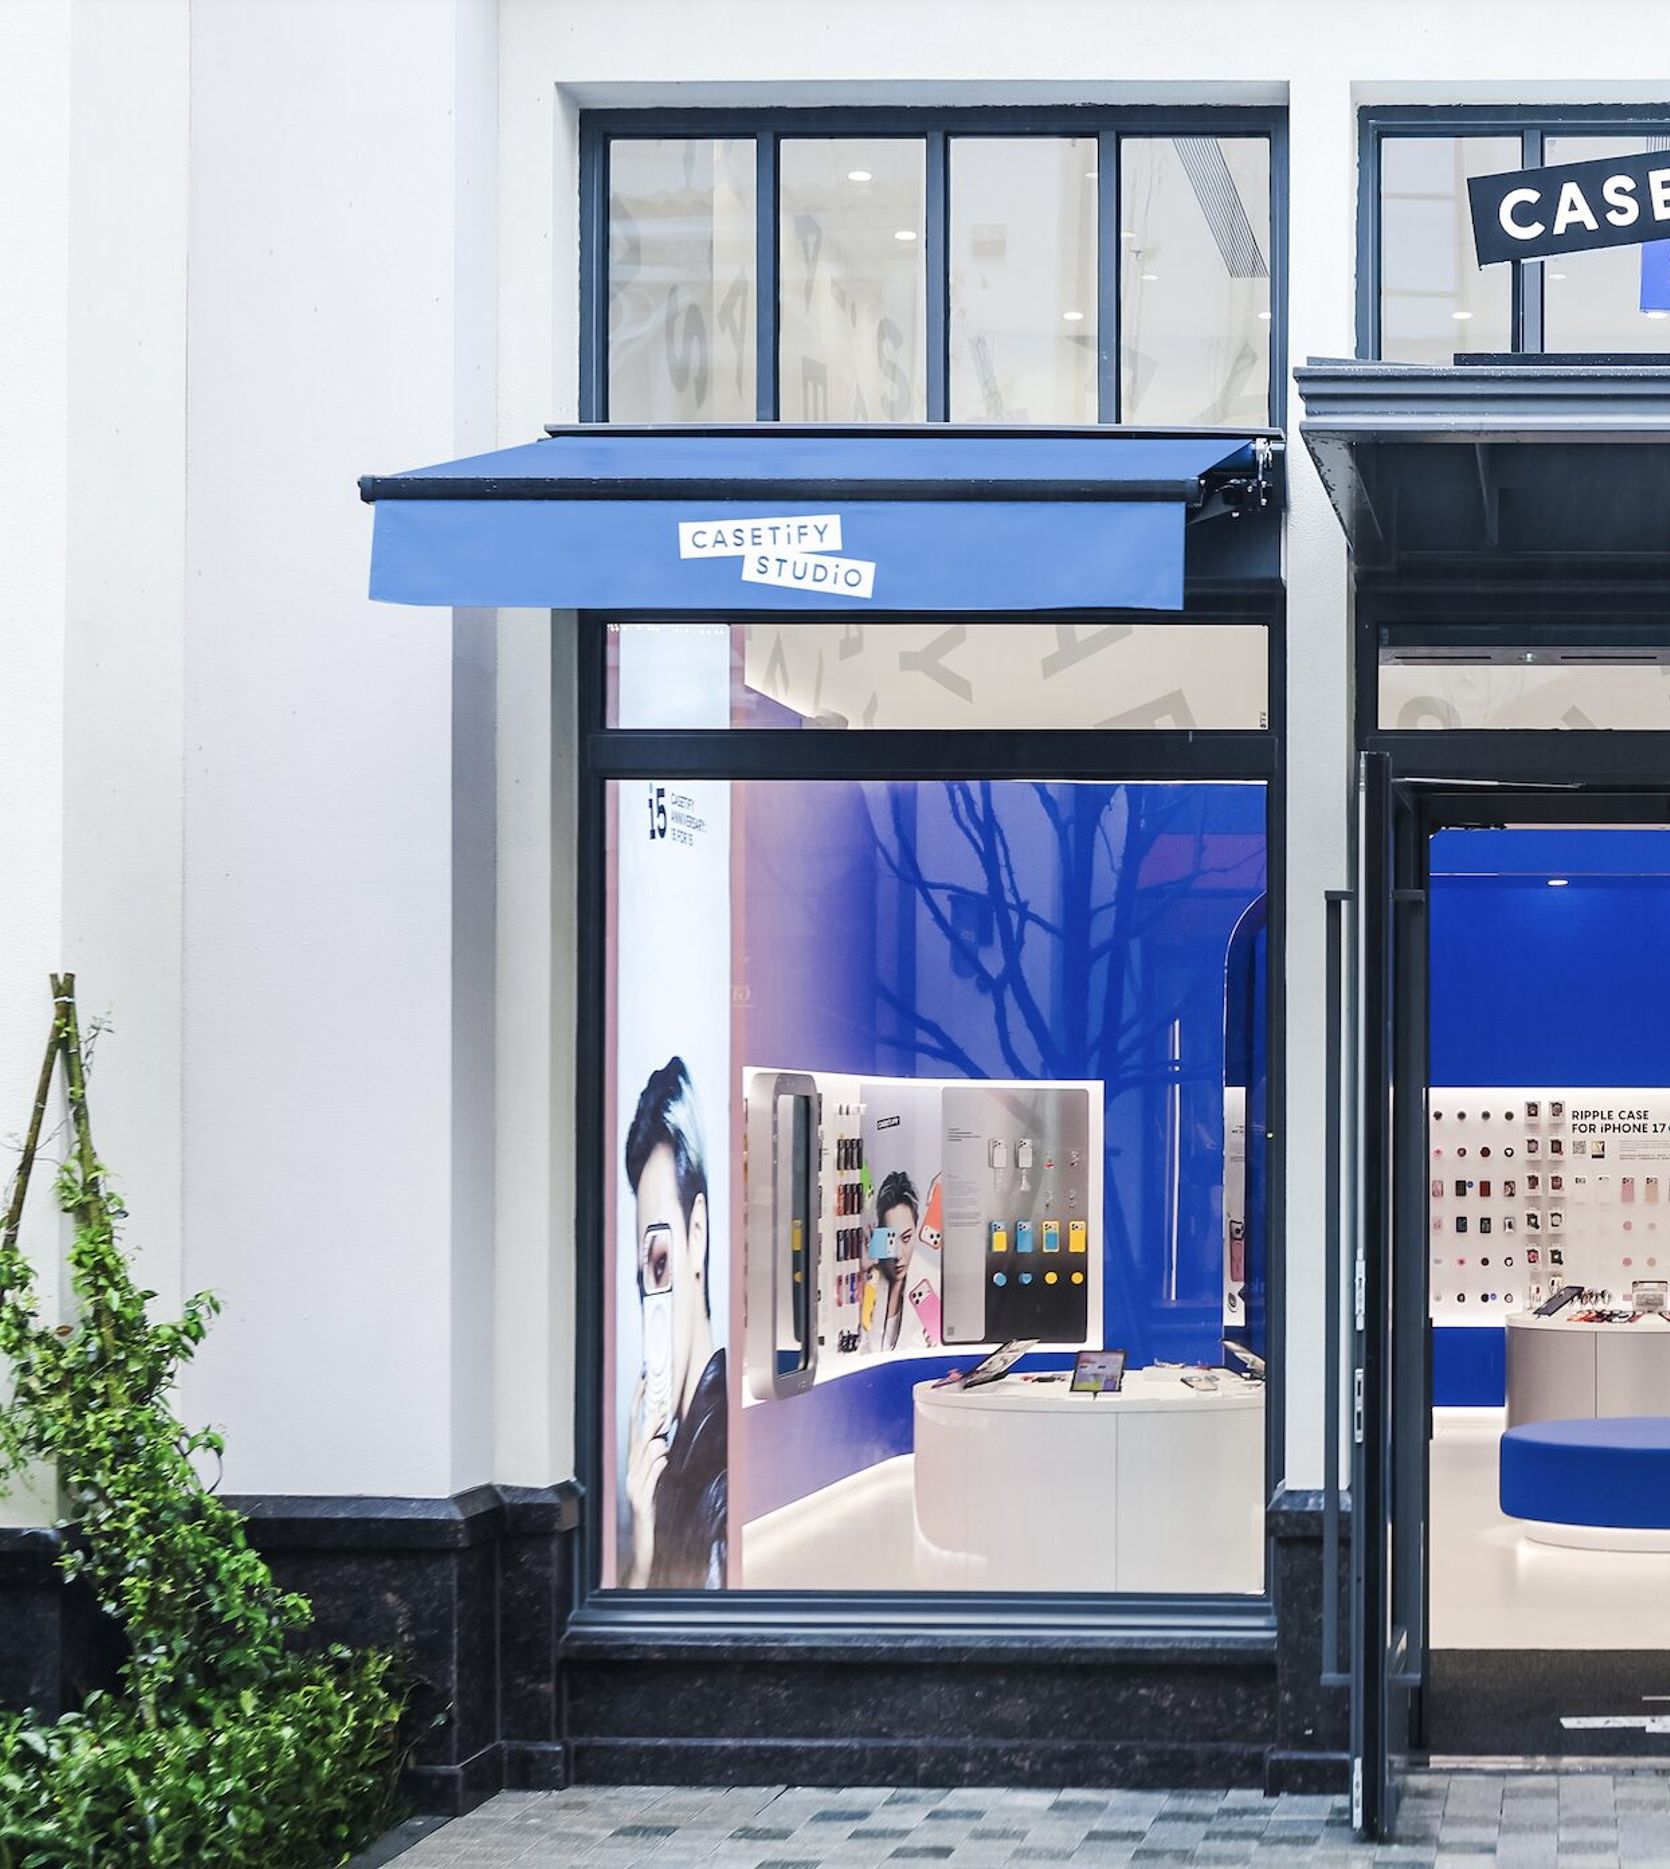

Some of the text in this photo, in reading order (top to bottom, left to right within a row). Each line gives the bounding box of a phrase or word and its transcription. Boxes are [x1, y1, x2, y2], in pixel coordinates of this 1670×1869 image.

[691, 523, 828, 549] CASETiFY
[755, 555, 862, 587] STUDiO
[1571, 1110, 1650, 1121] RIPPLE CASE
[1571, 1123, 1667, 1134] FOR iPHONE 17
